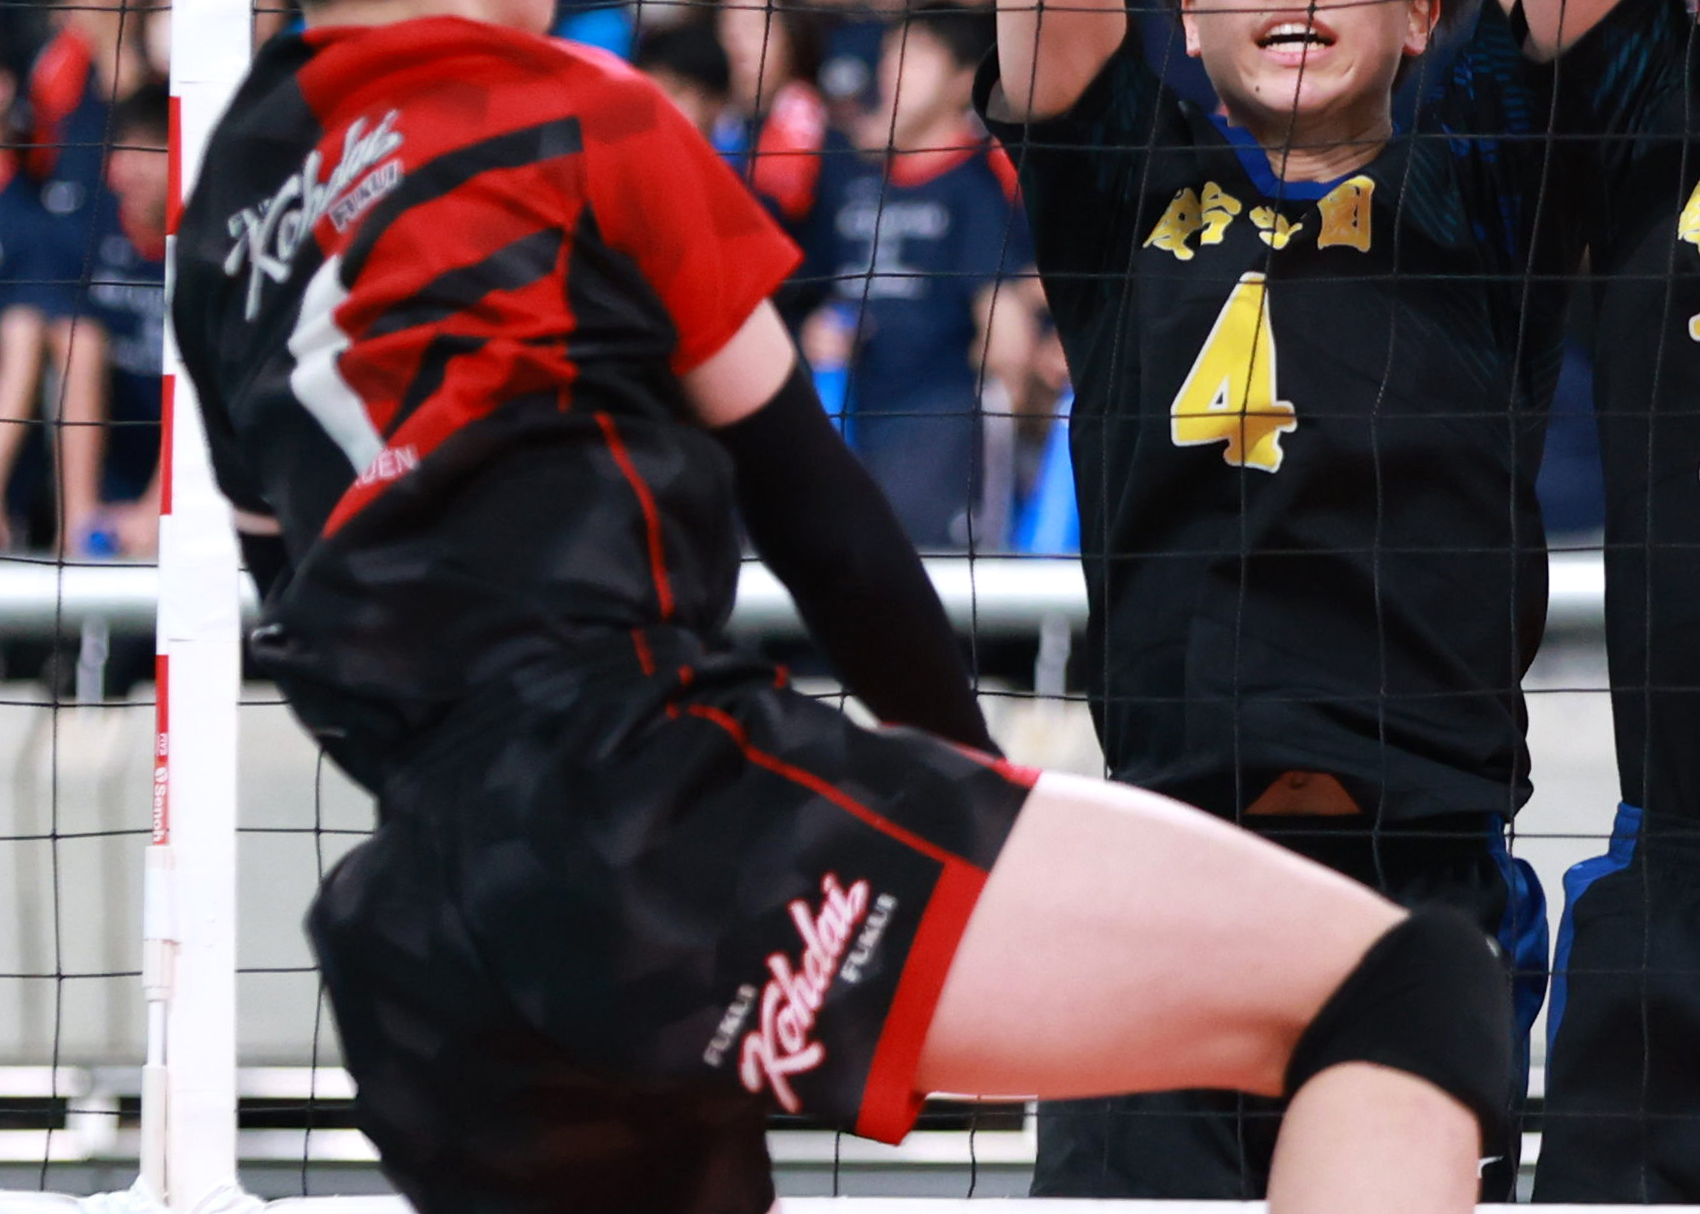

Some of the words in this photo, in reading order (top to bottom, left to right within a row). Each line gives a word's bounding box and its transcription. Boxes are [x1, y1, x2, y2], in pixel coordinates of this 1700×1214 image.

[1169, 271, 1298, 474] 4
[152, 784, 168, 843] Senoh
[838, 891, 898, 985] FUKUI
